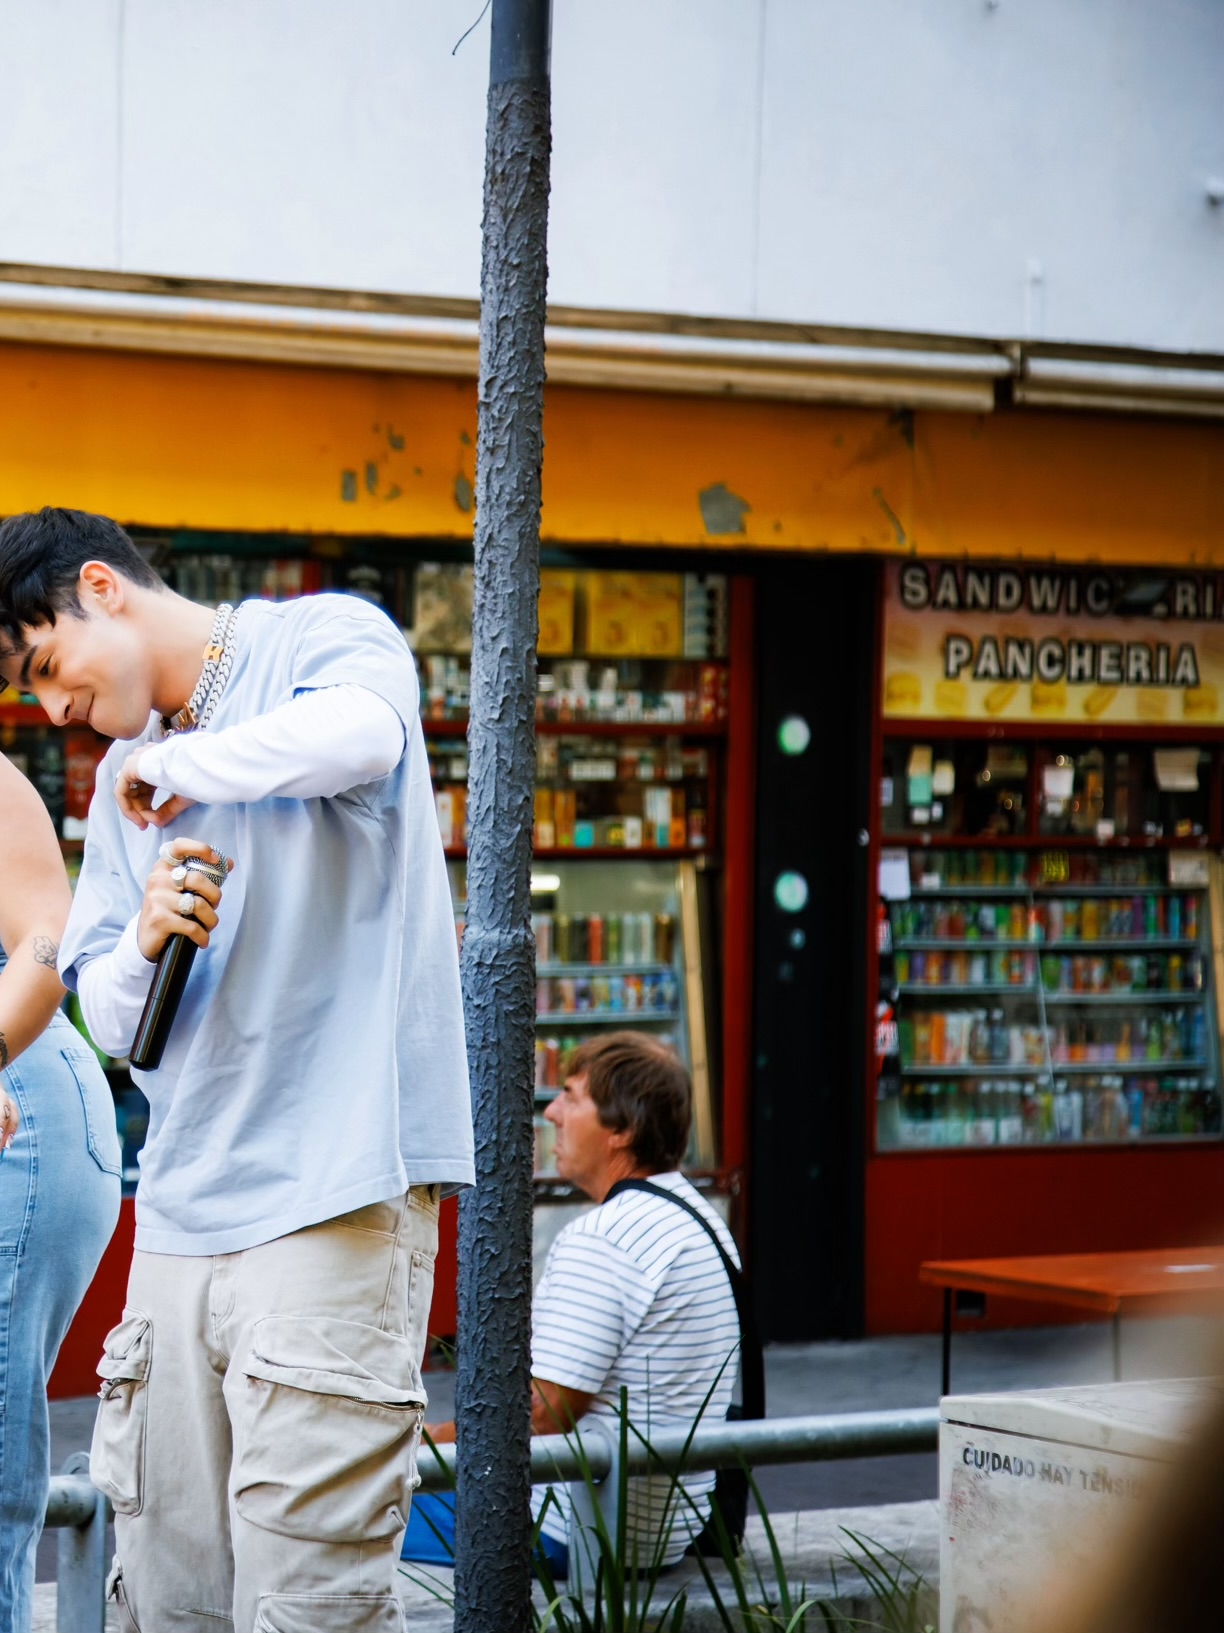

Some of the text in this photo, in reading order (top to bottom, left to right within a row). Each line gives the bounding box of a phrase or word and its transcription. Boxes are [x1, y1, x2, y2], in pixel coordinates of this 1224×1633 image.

[901, 565, 1224, 621] SANDWICRI
[945, 636, 1200, 685] PANCHERIA
[962, 1446, 1036, 1479] CUIDADO
[1040, 1461, 1075, 1487] HAY
